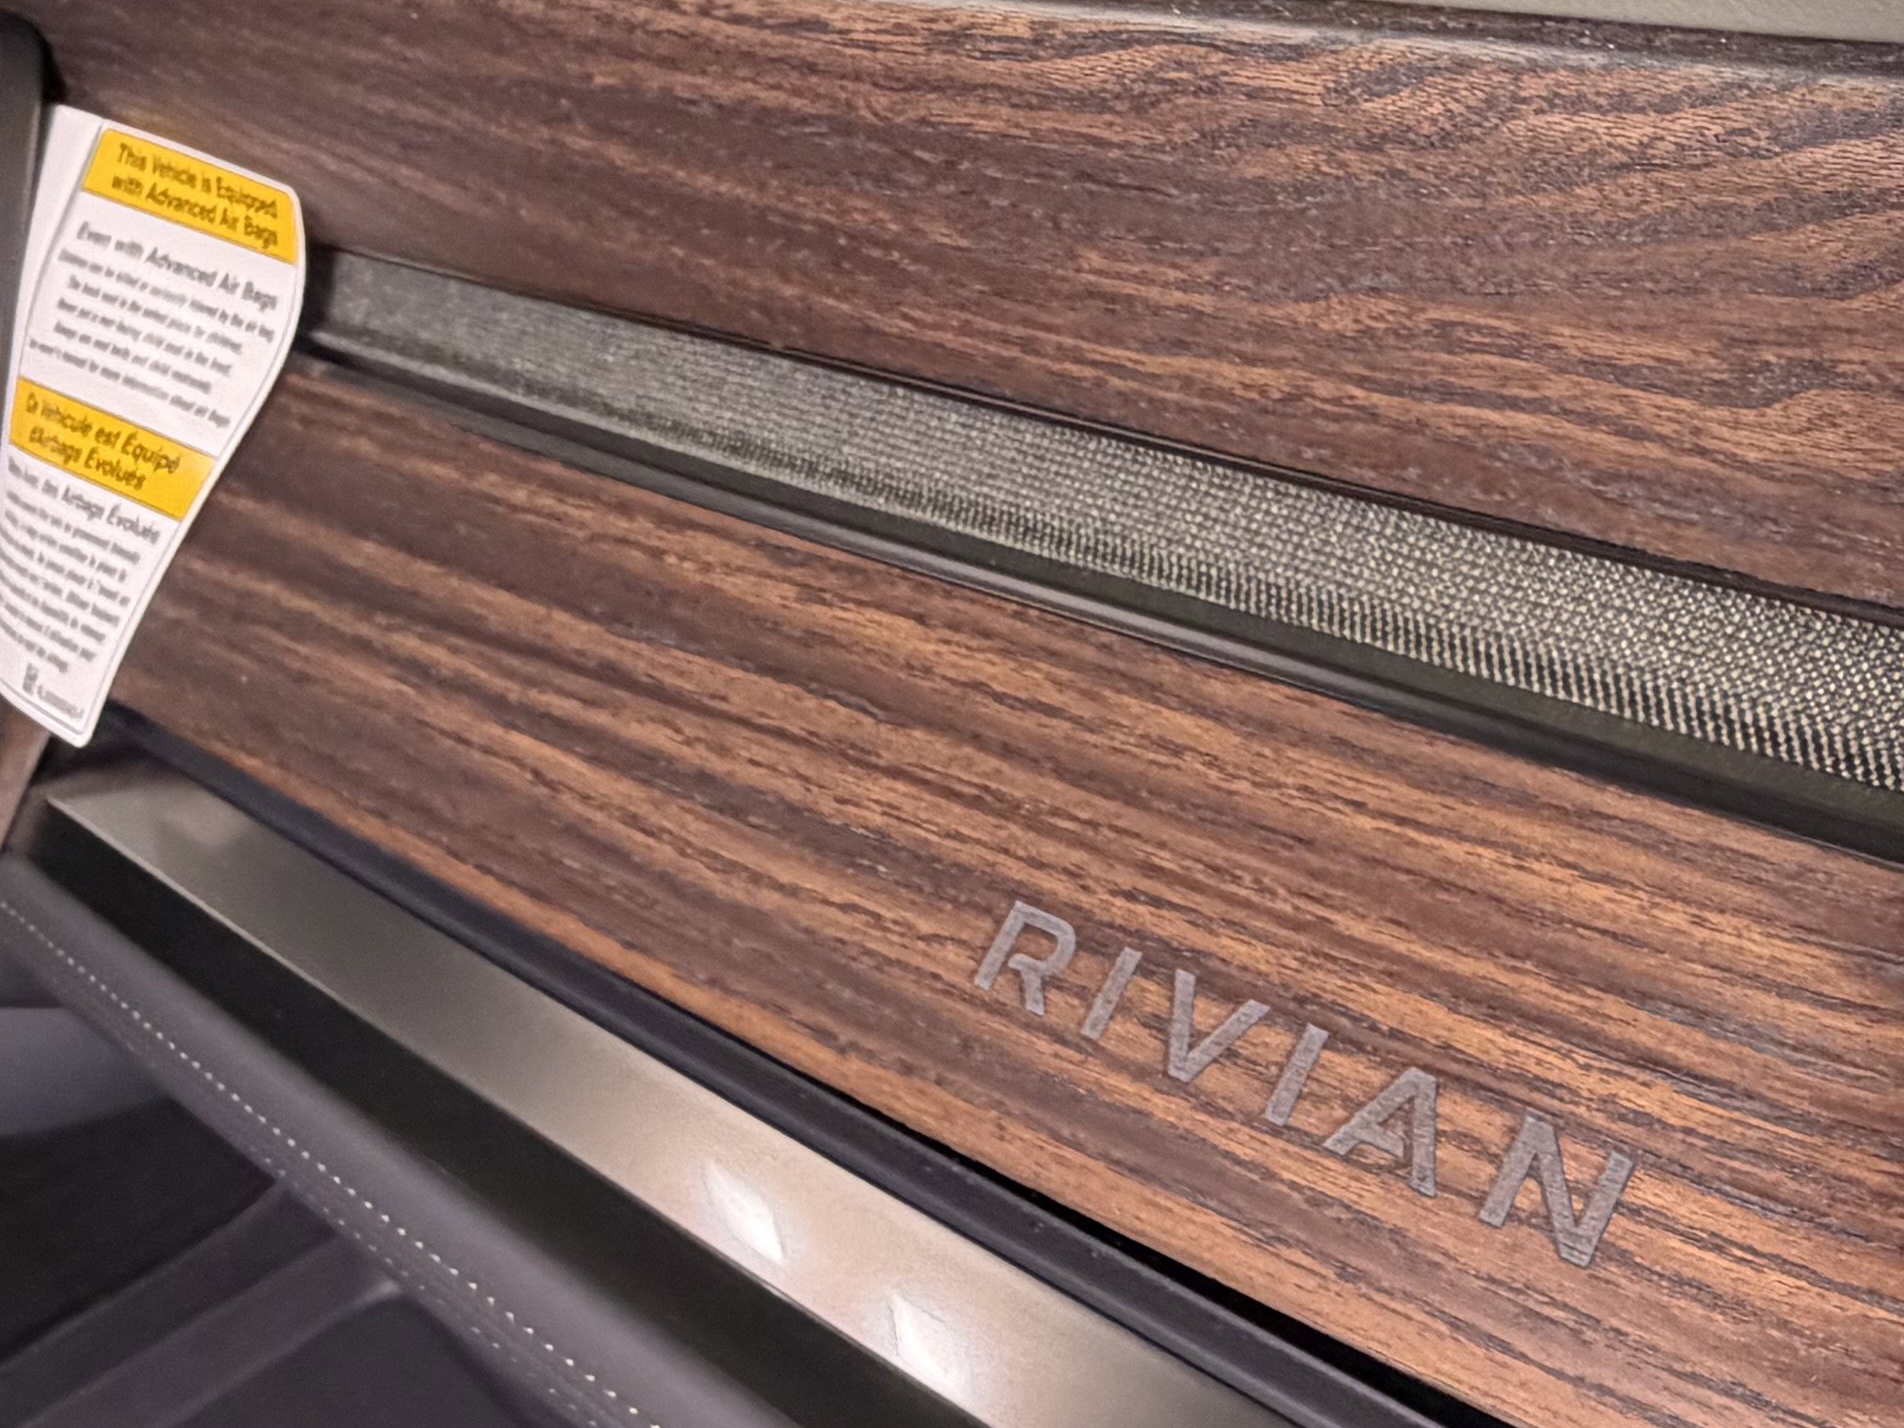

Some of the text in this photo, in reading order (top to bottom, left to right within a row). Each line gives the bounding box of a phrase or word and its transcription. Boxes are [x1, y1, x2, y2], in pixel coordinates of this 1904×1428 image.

[145, 182, 218, 225] Advanced
[243, 214, 278, 250] Bags
[974, 898, 1637, 1269] RIVIAN
